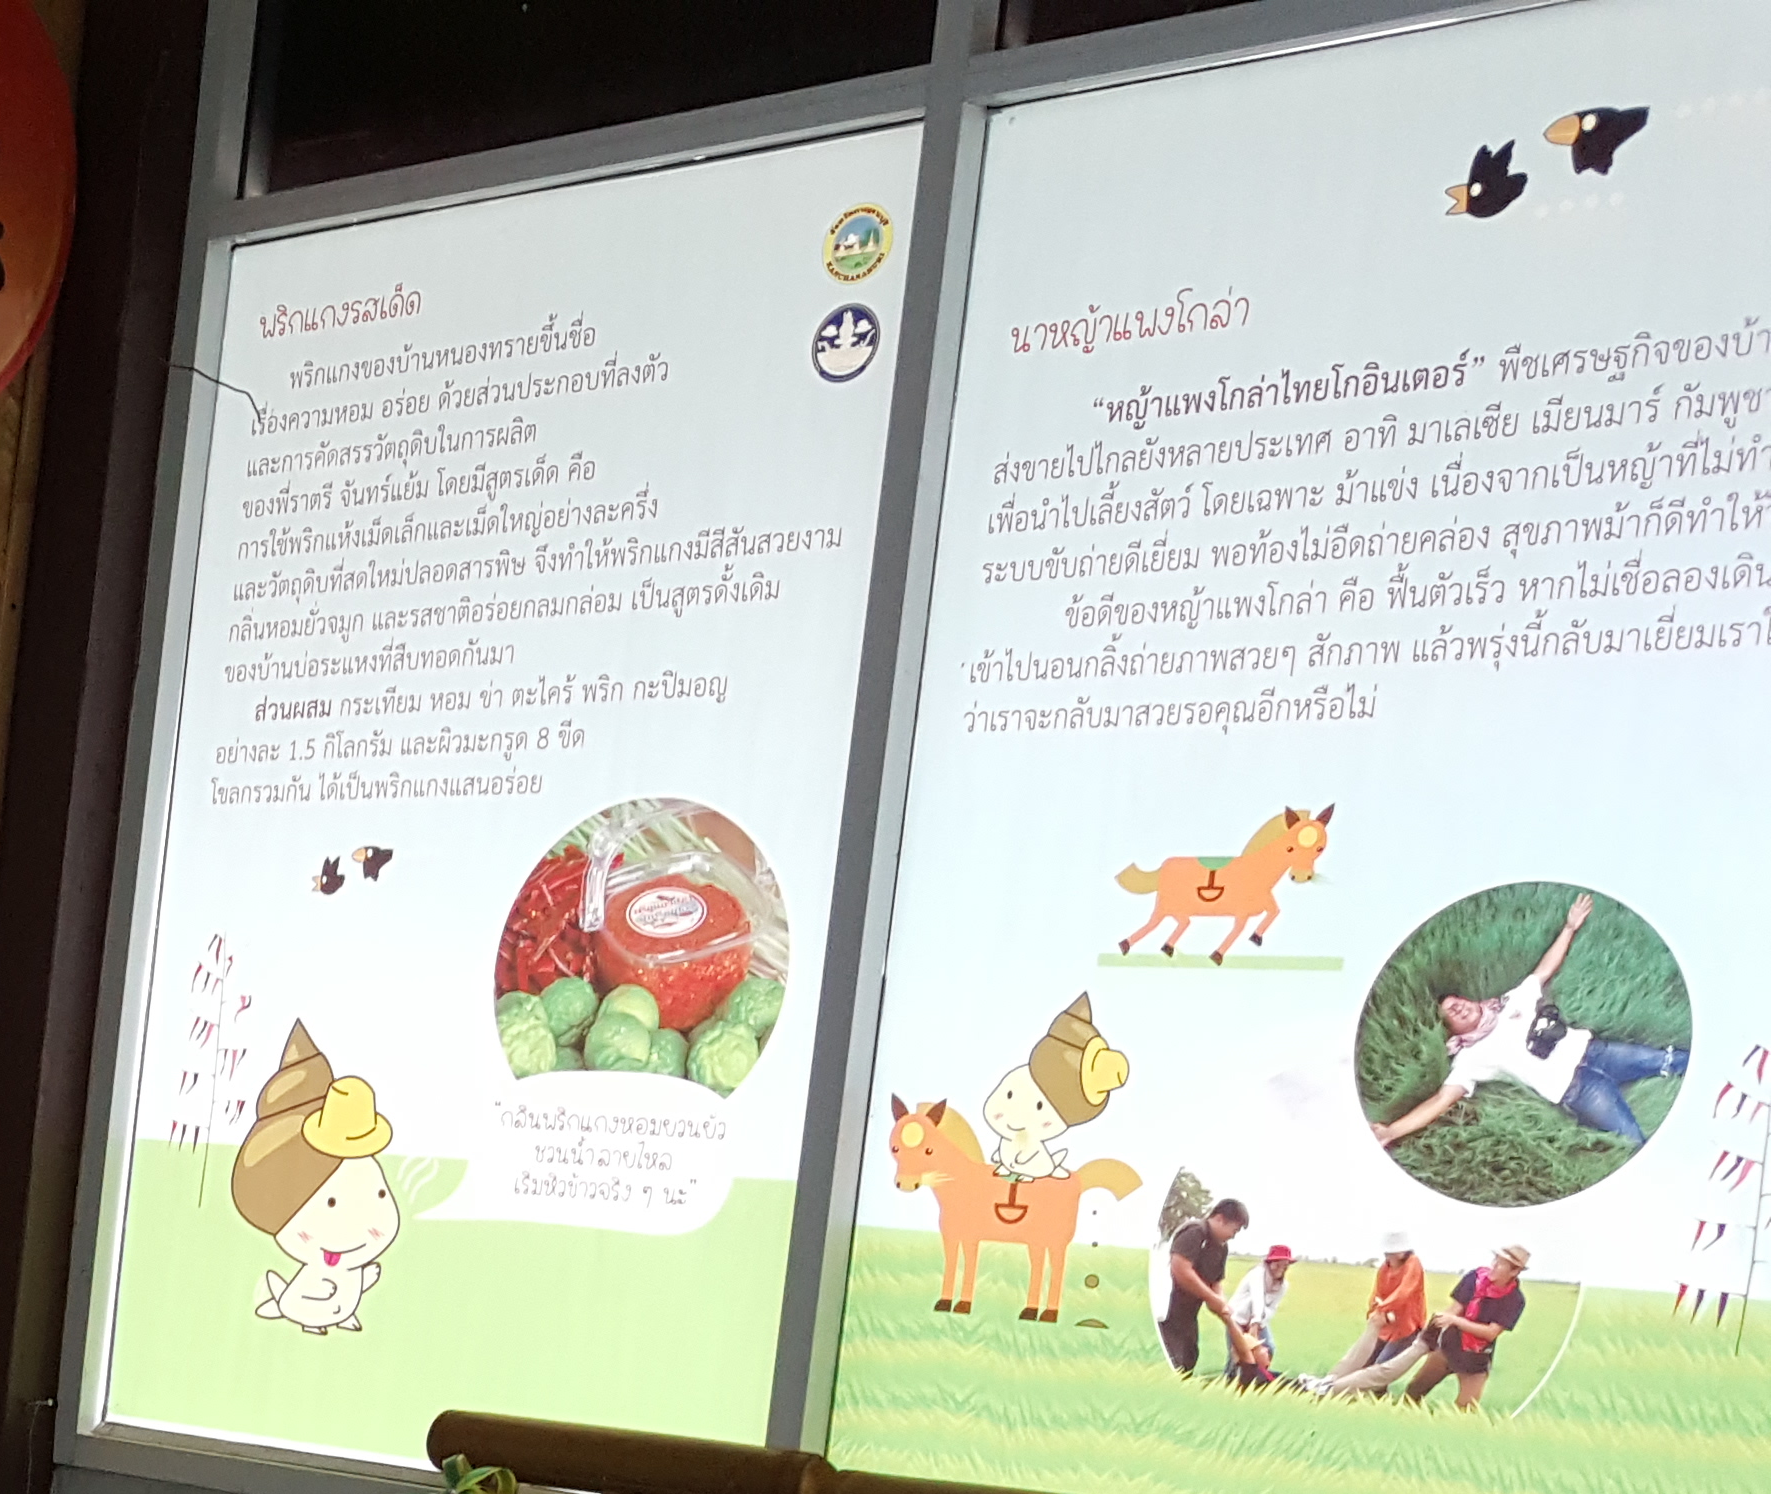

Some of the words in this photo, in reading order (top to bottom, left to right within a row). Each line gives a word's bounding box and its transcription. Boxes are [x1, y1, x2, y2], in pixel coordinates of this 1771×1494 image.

[259, 282, 421, 339] พริกแกงรสเด็ด
[1011, 286, 1250, 354] นาหญ้าแพงโกล่า
[289, 311, 596, 390] พริกแกงของบ้านหนองทรายขึ้นชื่อ
[250, 399, 374, 437] เรื่องความหอม
[381, 387, 430, 419] อร่อย
[438, 350, 669, 411] ด้วยส่วนประกอบที่ลงตัว
[247, 417, 537, 478] และการคัดสรรวัตถุดิบในการผลิต
[992, 429, 1333, 485] ส่งขายไปไกลยังหลายประเทศ
[1344, 413, 1396, 452] อาทิ
[1407, 401, 1519, 447] มาเลเซีย
[1531, 383, 1665, 435] เมียนมาร์
[1673, 382, 1771, 429] กัมพูช
[242, 480, 333, 519] ของพี่ราตรี
[340, 468, 429, 509] จันทร์แย้ม
[437, 453, 559, 501] โดยมีสูตรเด็ด
[568, 450, 595, 483] คือ
[987, 480, 1195, 535] เพื่อนำไปเลี้ยงสัตว์
[1202, 481, 1325, 518] โดยเฉพาะ
[1334, 465, 1419, 506] ม้าแข่ง
[238, 482, 658, 560] การใช้พริกแห้งเม็ดเล็กและเม็ดใหญ่อย่างละครึ่ง
[982, 529, 1201, 585] ระบบขับถ่ายดีเยี่ยม
[1211, 515, 1490, 571] พอท้องไม่อืดถ่ายคล่อง
[233, 550, 526, 604] และวัตถุดิบที่สดใหม่ปลอดสารพิษ
[535, 526, 843, 575] จึงทำให้พริกแกงมีสีสันสวยงาม
[1064, 579, 1328, 630] ข้อดีของหญ้าแพงโกล่า
[1338, 576, 1374, 612] คือ
[1387, 562, 1506, 611] ฟื้นตัวเร็ว
[228, 600, 364, 643] กลิ่นหอมยั่วจมูก
[371, 585, 622, 632] และรสชาติอร่อยกลมกล่อม
[631, 563, 781, 618] เป็นสูตรดั้งเดิม
[224, 636, 515, 684] ของบ้านบ่อระแหงที่สืบทอดกันมา
[1307, 631, 1401, 668] สักภาพ
[254, 694, 332, 722] ส่วนผสม
[339, 685, 422, 717] กระเทียม
[430, 686, 471, 712] หอม
[479, 679, 503, 709] ข่า
[511, 673, 577, 707] ตะไคร้
[582, 674, 624, 703] พริก
[633, 669, 728, 704] กะปิมอญ
[962, 682, 1379, 735] ว่าเราจะกลับมาสวยรอคุณอีกหรือไม่
[215, 737, 280, 765] อย่างละ
[288, 738, 316, 762] 1.5
[323, 728, 393, 760] กิโลกรัม
[400, 725, 528, 762] และผิวมะกรูด
[537, 727, 549, 749] 8
[558, 718, 585, 750] ขีด
[210, 776, 311, 806] โขลกรวมกัน
[319, 766, 543, 802] ได้เป็นพริกแกงแสนอร่อย
